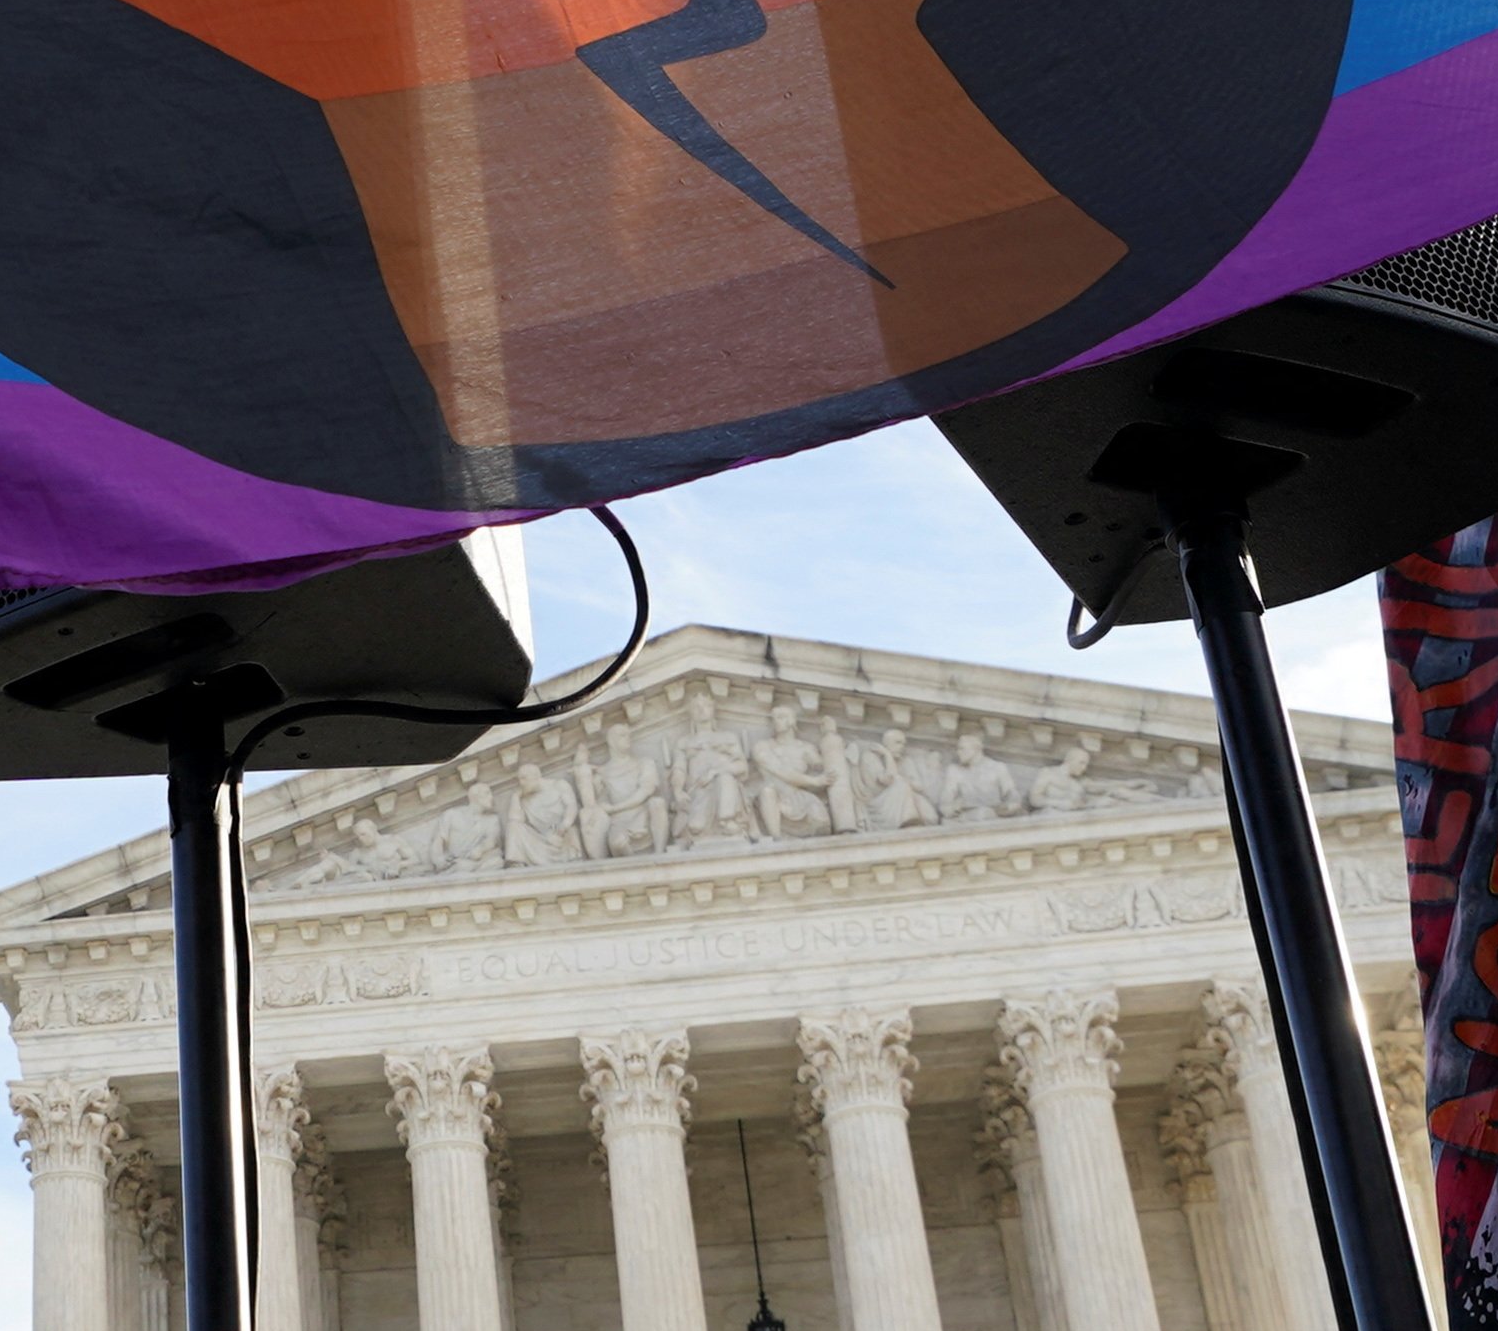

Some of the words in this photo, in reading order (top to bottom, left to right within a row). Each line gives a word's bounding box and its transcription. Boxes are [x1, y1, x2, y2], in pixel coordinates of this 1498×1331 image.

[457, 949, 593, 985] EQUAL
[607, 931, 761, 970] JUSTICE
[780, 914, 922, 954] UNDER
[937, 906, 1015, 939] LAW
